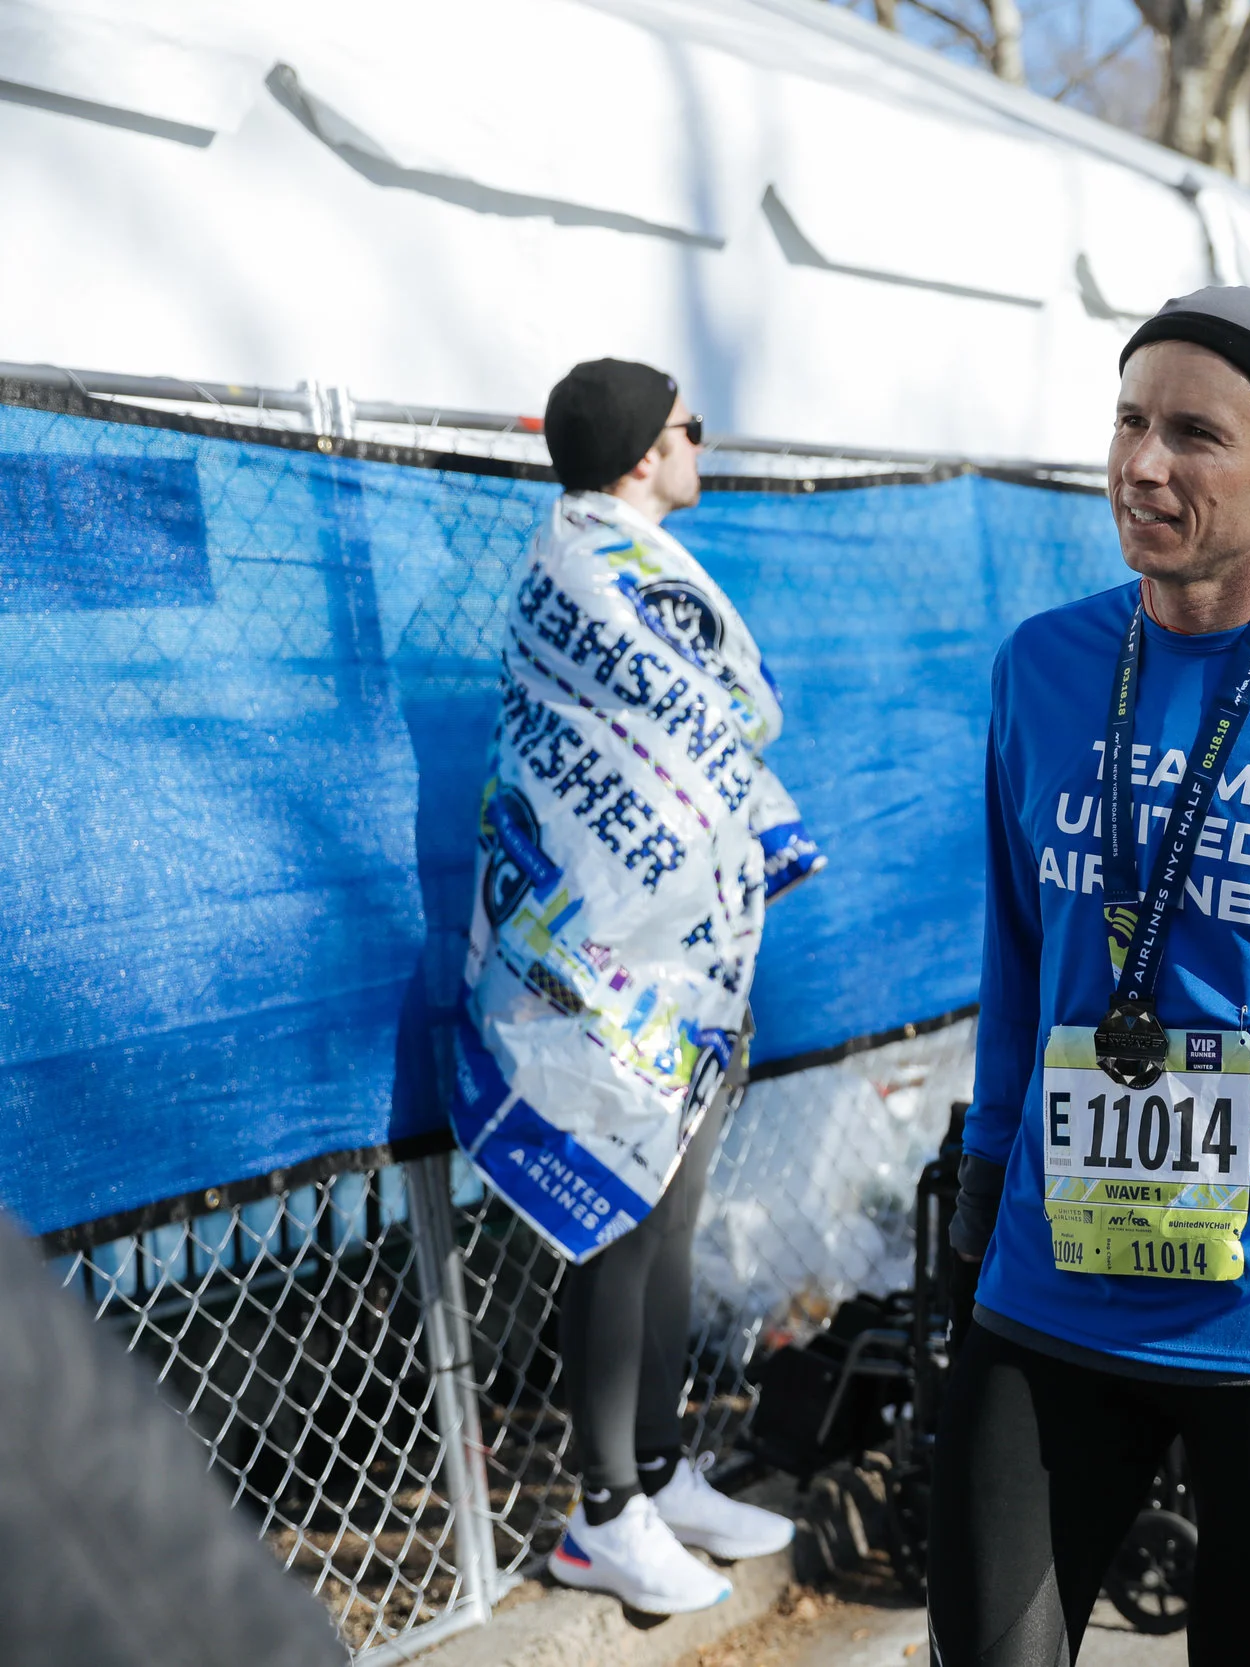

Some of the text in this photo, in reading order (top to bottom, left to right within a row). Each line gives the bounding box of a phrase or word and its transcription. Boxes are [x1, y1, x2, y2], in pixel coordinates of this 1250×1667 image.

[1118, 667, 1131, 716] 03.18.18
[500, 672, 688, 893] NISHER
[1134, 888, 1169, 983] AIRLINES
[1163, 841, 1184, 882] NYC
[1178, 782, 1203, 836] HALF
[1202, 719, 1231, 769] 03.18.18
[1191, 1039, 1216, 1051] VIP
[1050, 1092, 1071, 1146] E
[1083, 1093, 1237, 1174] 11014
[508, 1148, 600, 1230] AIRLINES
[538, 1148, 611, 1215] UNITED
[1105, 1184, 1161, 1201] WAVE 1
[1053, 1214, 1082, 1222] AIRLINES
[1058, 1208, 1082, 1216] UNITED
[1168, 1220, 1231, 1230] #UnitedNYCHalf
[1054, 1240, 1084, 1265] 11014
[1131, 1240, 1207, 1275] 11014
